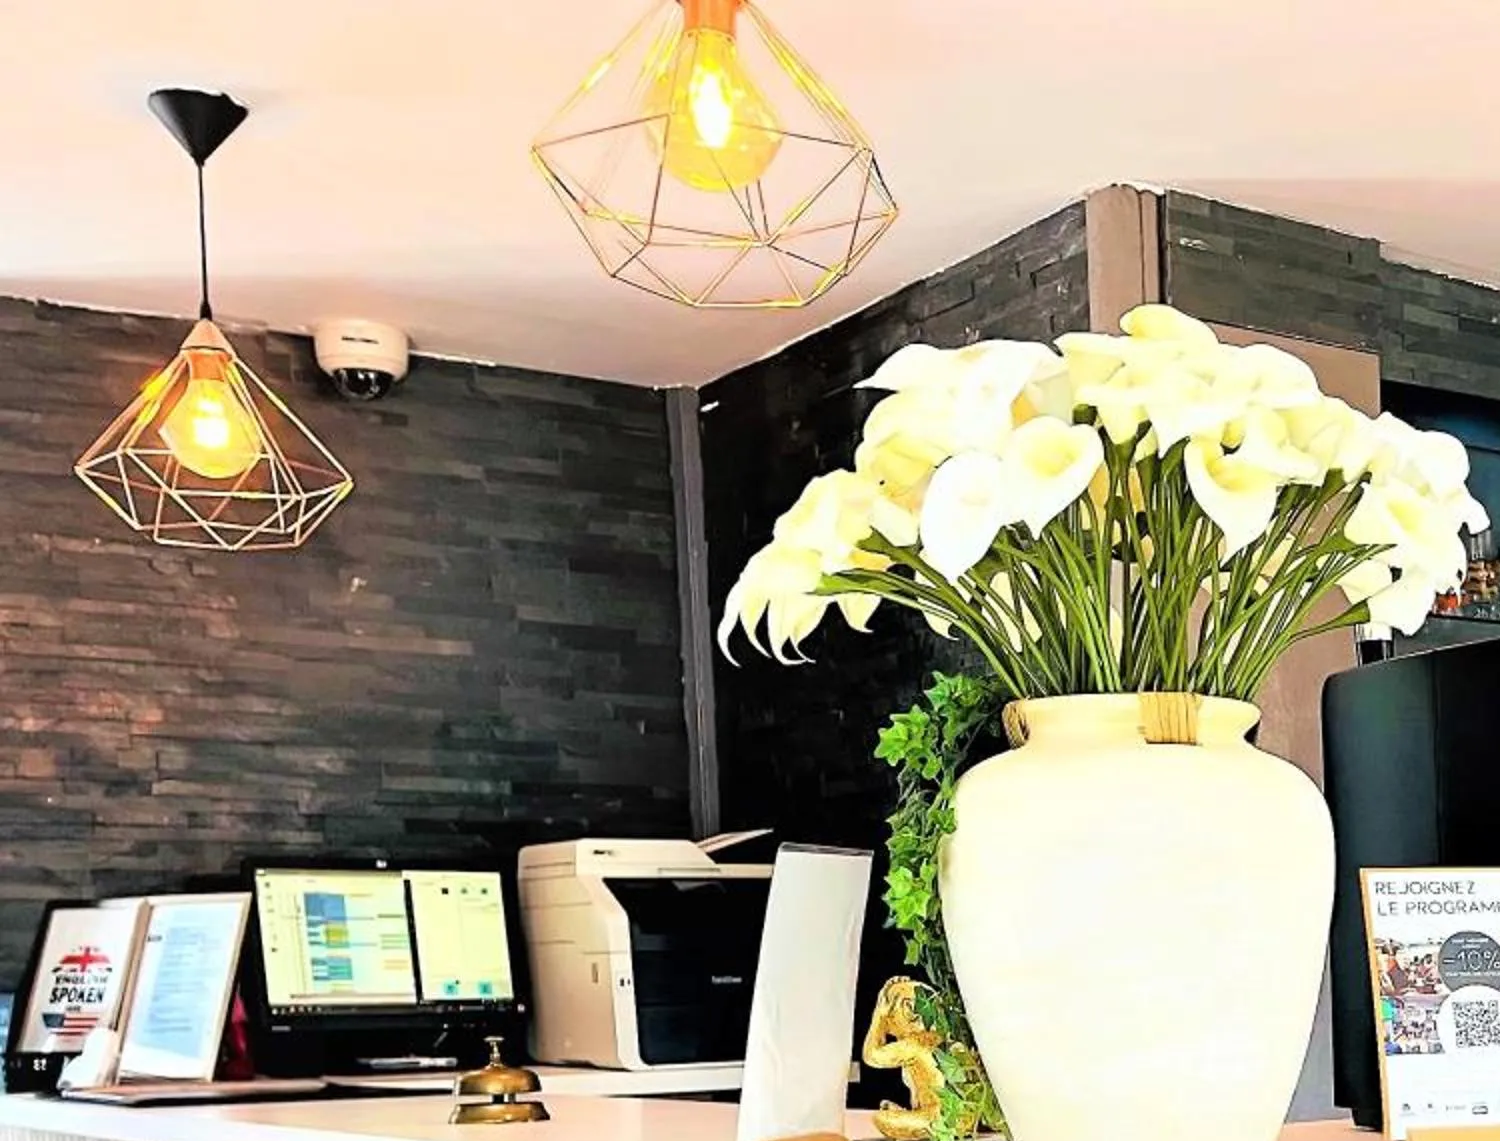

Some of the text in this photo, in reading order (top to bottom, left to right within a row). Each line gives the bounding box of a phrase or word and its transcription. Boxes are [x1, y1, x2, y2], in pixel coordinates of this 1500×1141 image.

[1374, 880, 1476, 895] REJOIGNEZ
[1377, 901, 1399, 916] LE
[50, 986, 105, 1003] SPOKEN
